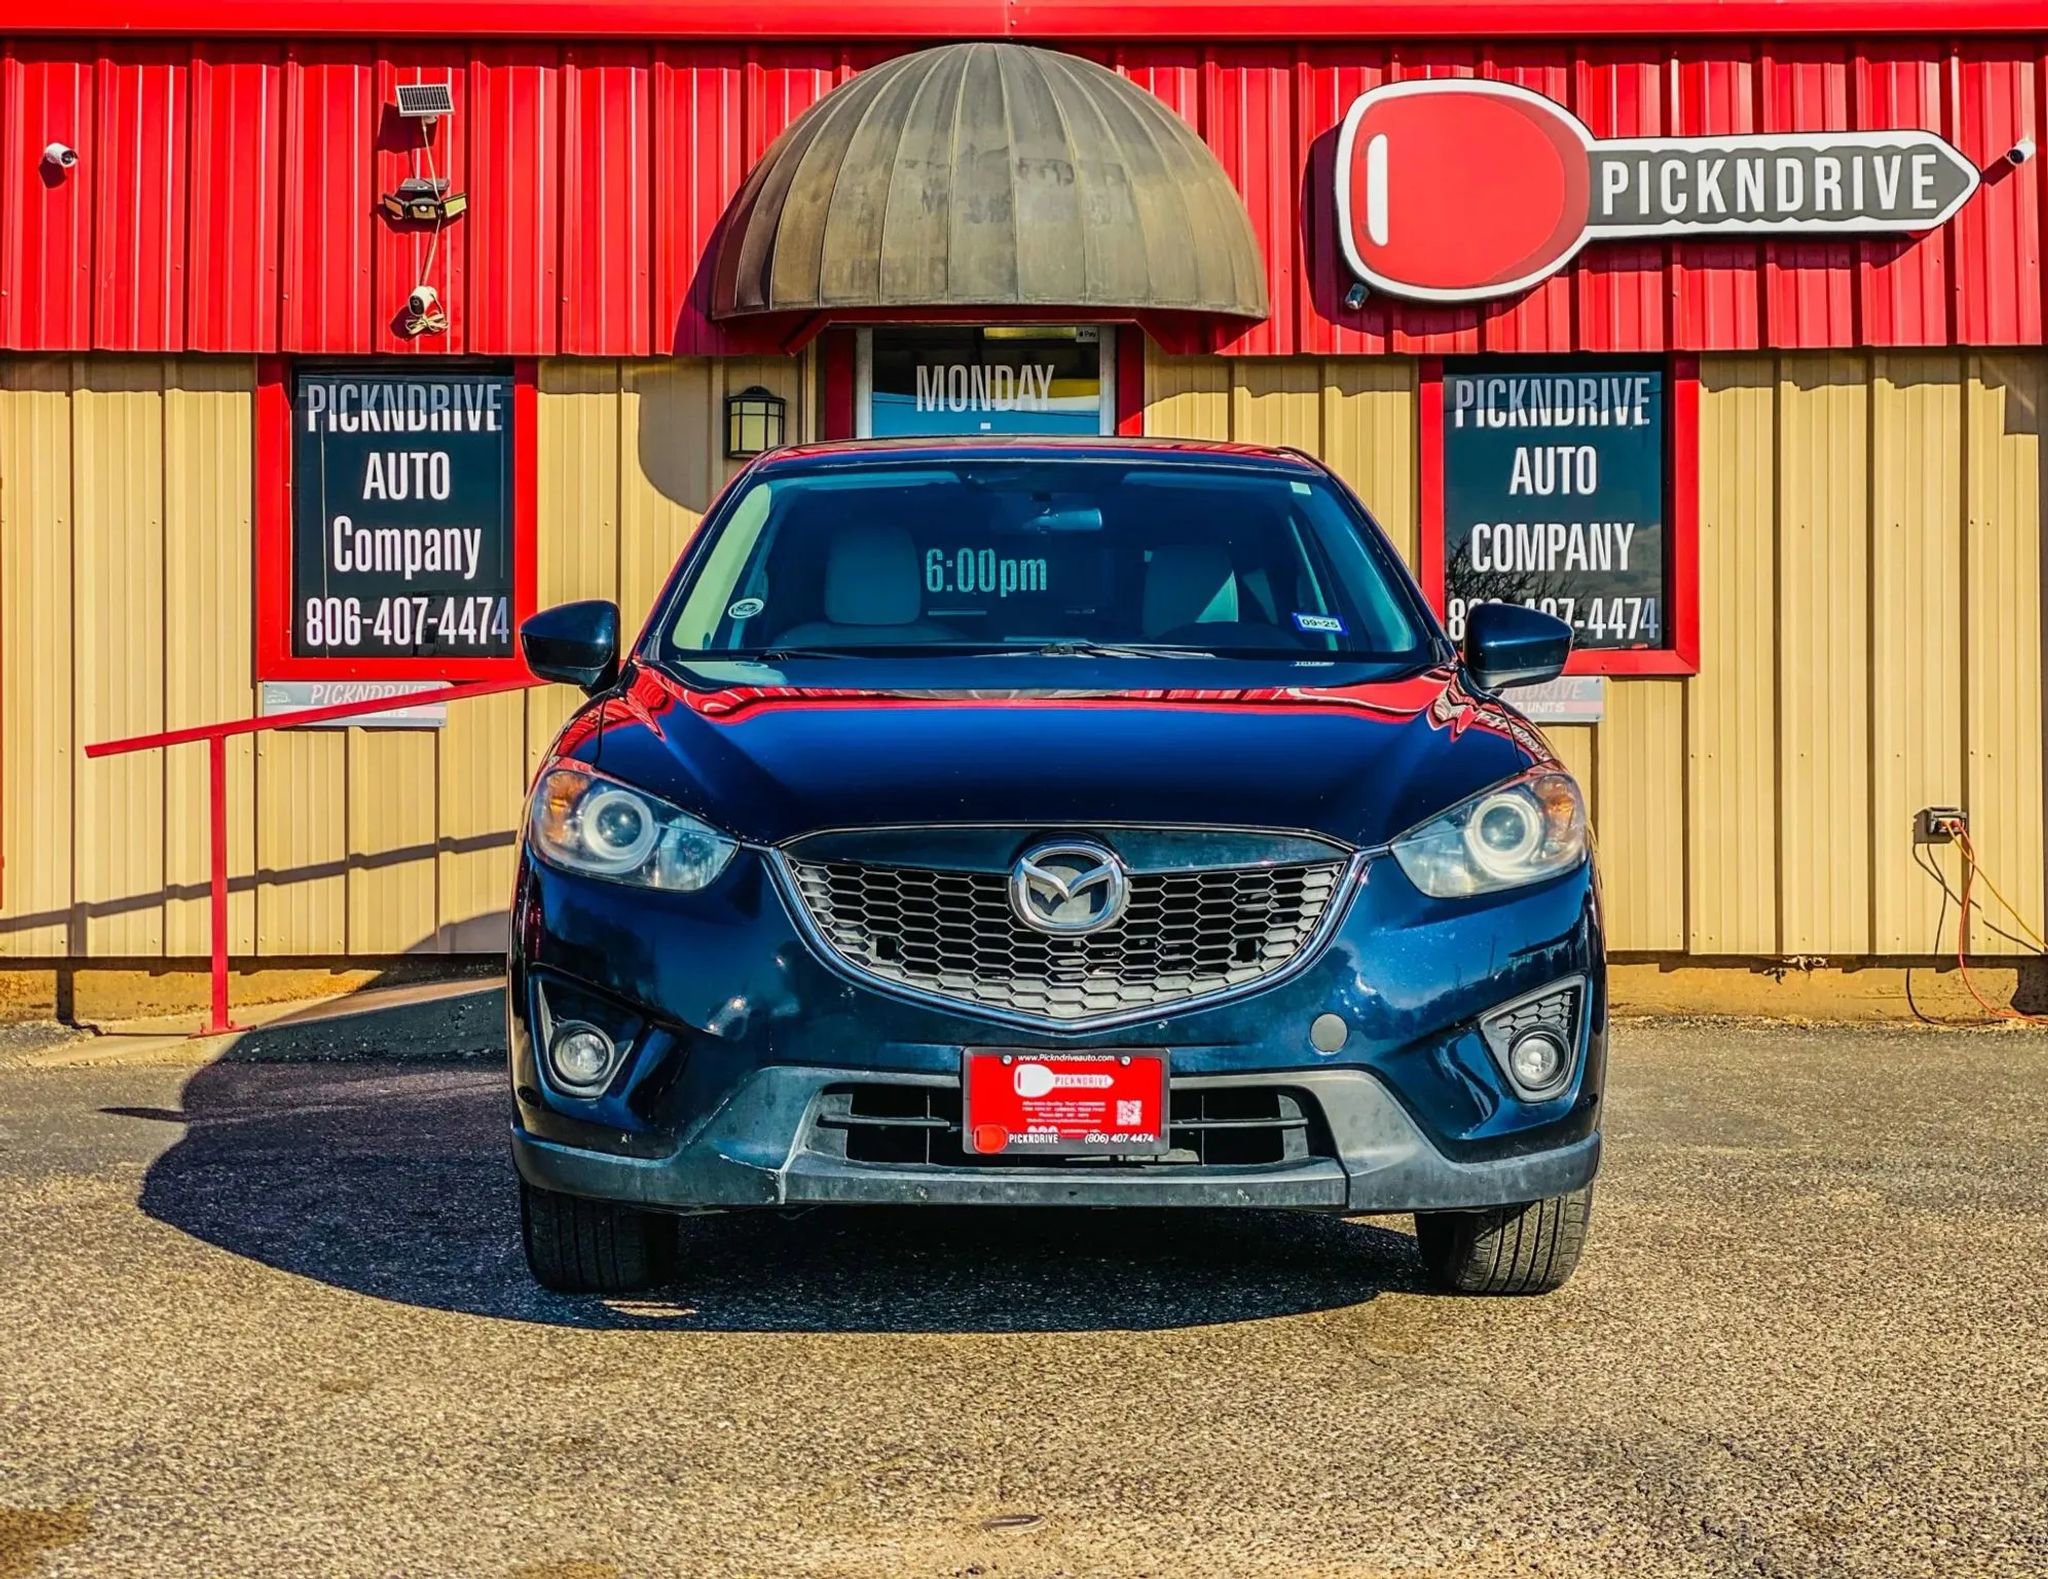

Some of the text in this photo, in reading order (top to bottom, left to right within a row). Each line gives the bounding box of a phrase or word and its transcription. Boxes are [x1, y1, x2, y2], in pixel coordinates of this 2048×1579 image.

[1602, 154, 1937, 215] PICKNDRIVE
[307, 384, 503, 432] PICKNDRIVE
[916, 364, 1055, 412] MONDAY
[1455, 378, 1650, 428] PICKNDRIVE
[362, 451, 451, 500] AUTO
[1509, 446, 1597, 495] AUTO
[333, 515, 482, 580] Company
[1471, 523, 1635, 572] COMPANY
[926, 548, 1047, 597] 6:00pm
[306, 596, 510, 646] 806-407-4474
[1017, 1053, 1115, 1062] www.Pickndriveauto.com
[1055, 1076, 1108, 1086] PICKNDRIVE
[1008, 1133, 1059, 1144] PICKNDRIVE
[1085, 1133, 1154, 1145] (806) 407 4474
